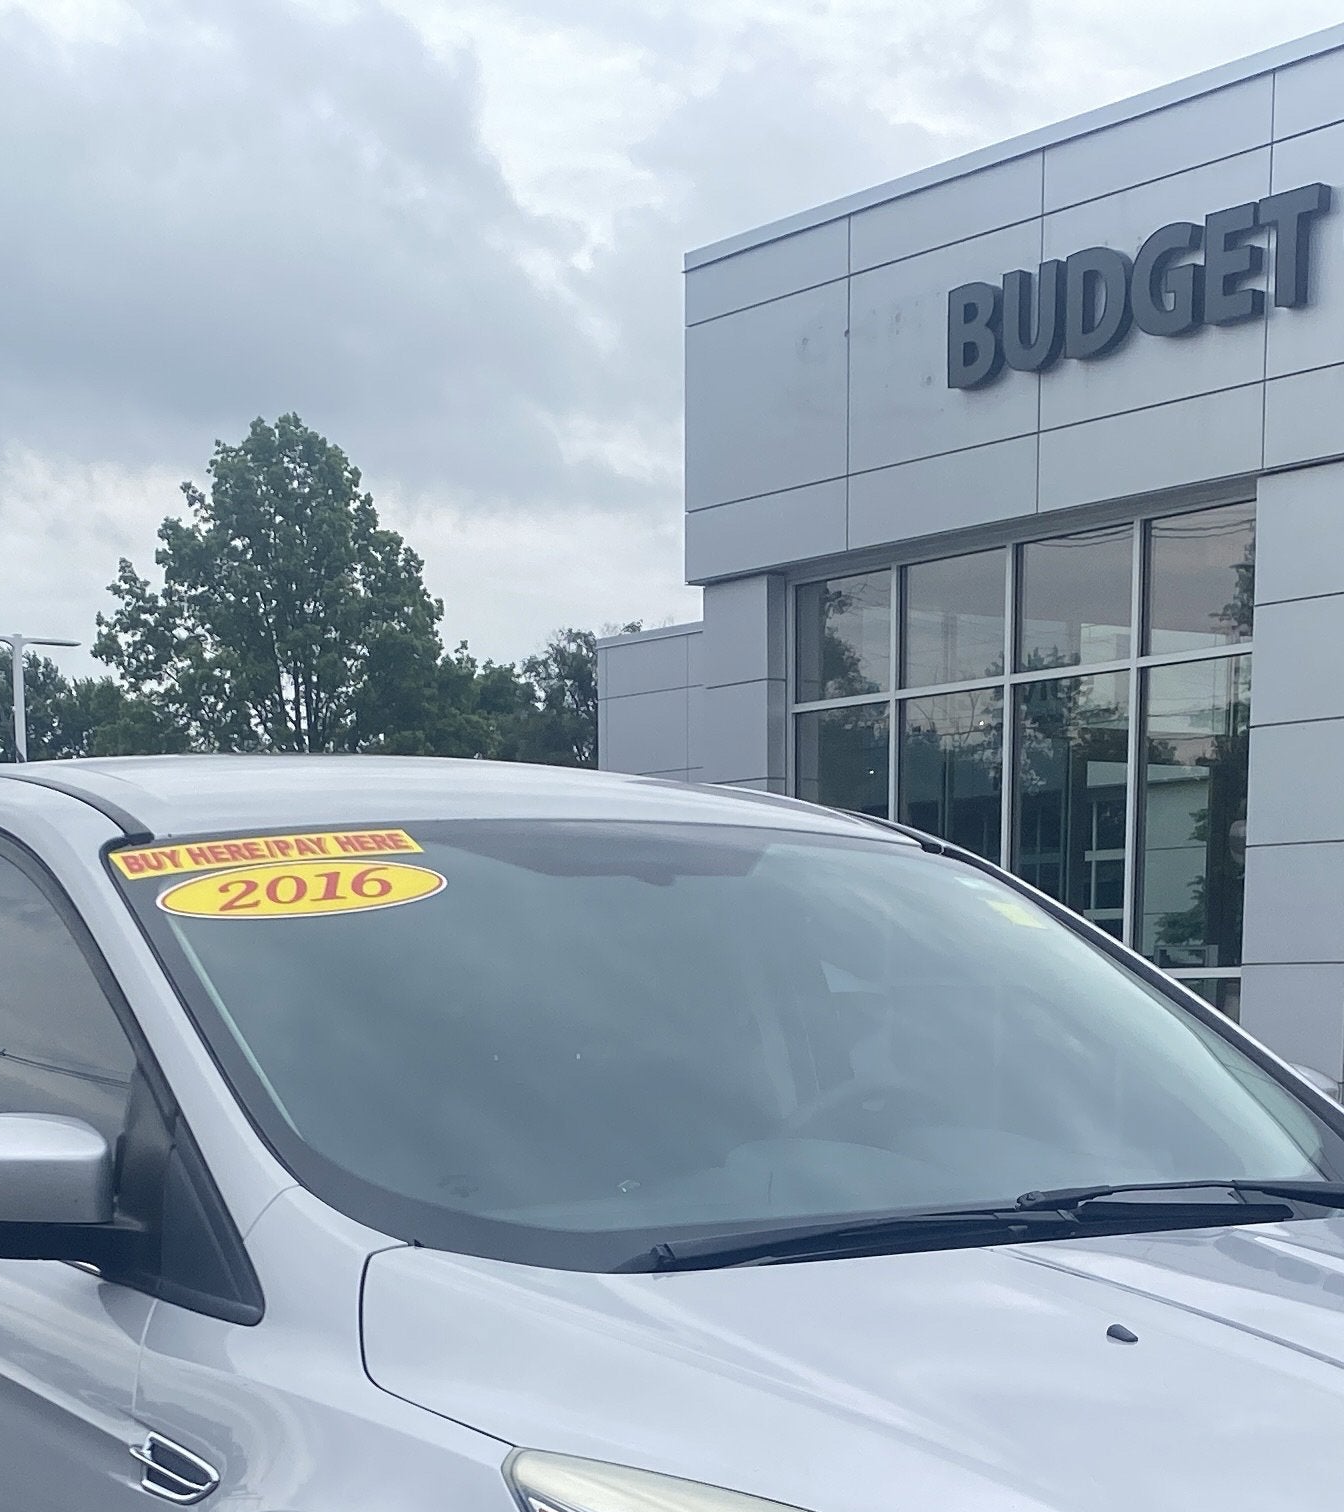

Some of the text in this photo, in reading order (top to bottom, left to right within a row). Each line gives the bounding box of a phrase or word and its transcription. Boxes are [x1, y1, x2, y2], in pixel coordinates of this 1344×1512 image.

[947, 182, 1333, 390] BUDGET
[121, 849, 183, 874] BUY
[333, 833, 414, 853] HERE
[218, 866, 393, 912] 2016
